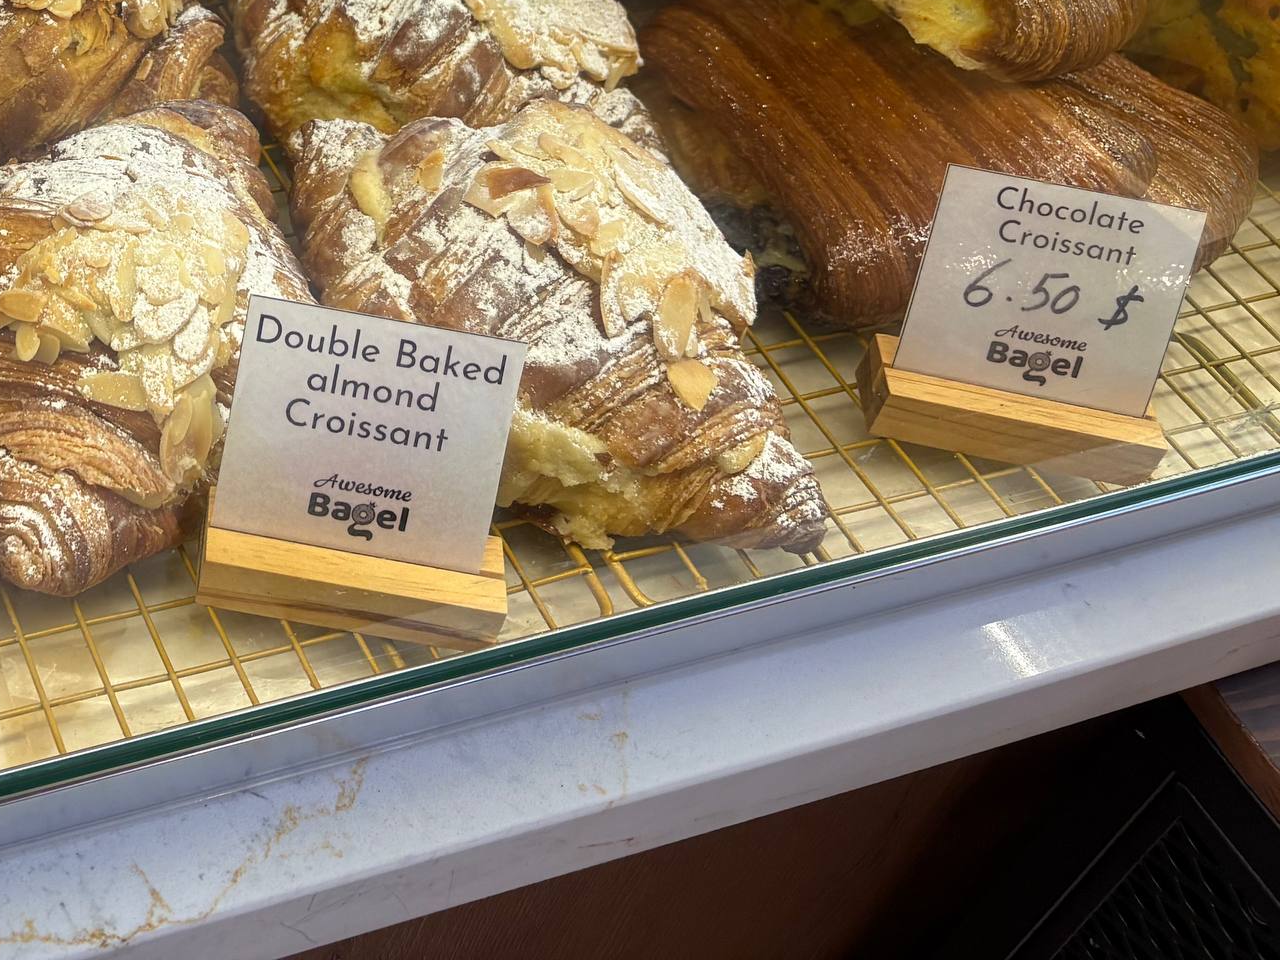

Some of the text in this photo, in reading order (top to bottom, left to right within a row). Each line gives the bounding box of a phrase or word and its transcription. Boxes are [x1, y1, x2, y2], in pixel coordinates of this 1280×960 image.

[996, 186, 1145, 234] Chocolate
[999, 220, 1137, 266] Croissant
[963, 258, 1144, 331] 6.50 $
[256, 314, 508, 385] Double Baked
[994, 325, 1088, 352] Awesome
[986, 341, 1083, 386] Bagel
[307, 364, 440, 412] almond
[285, 398, 449, 452] Croissant
[313, 473, 413, 502] Awesome
[307, 492, 410, 541] Bagel
